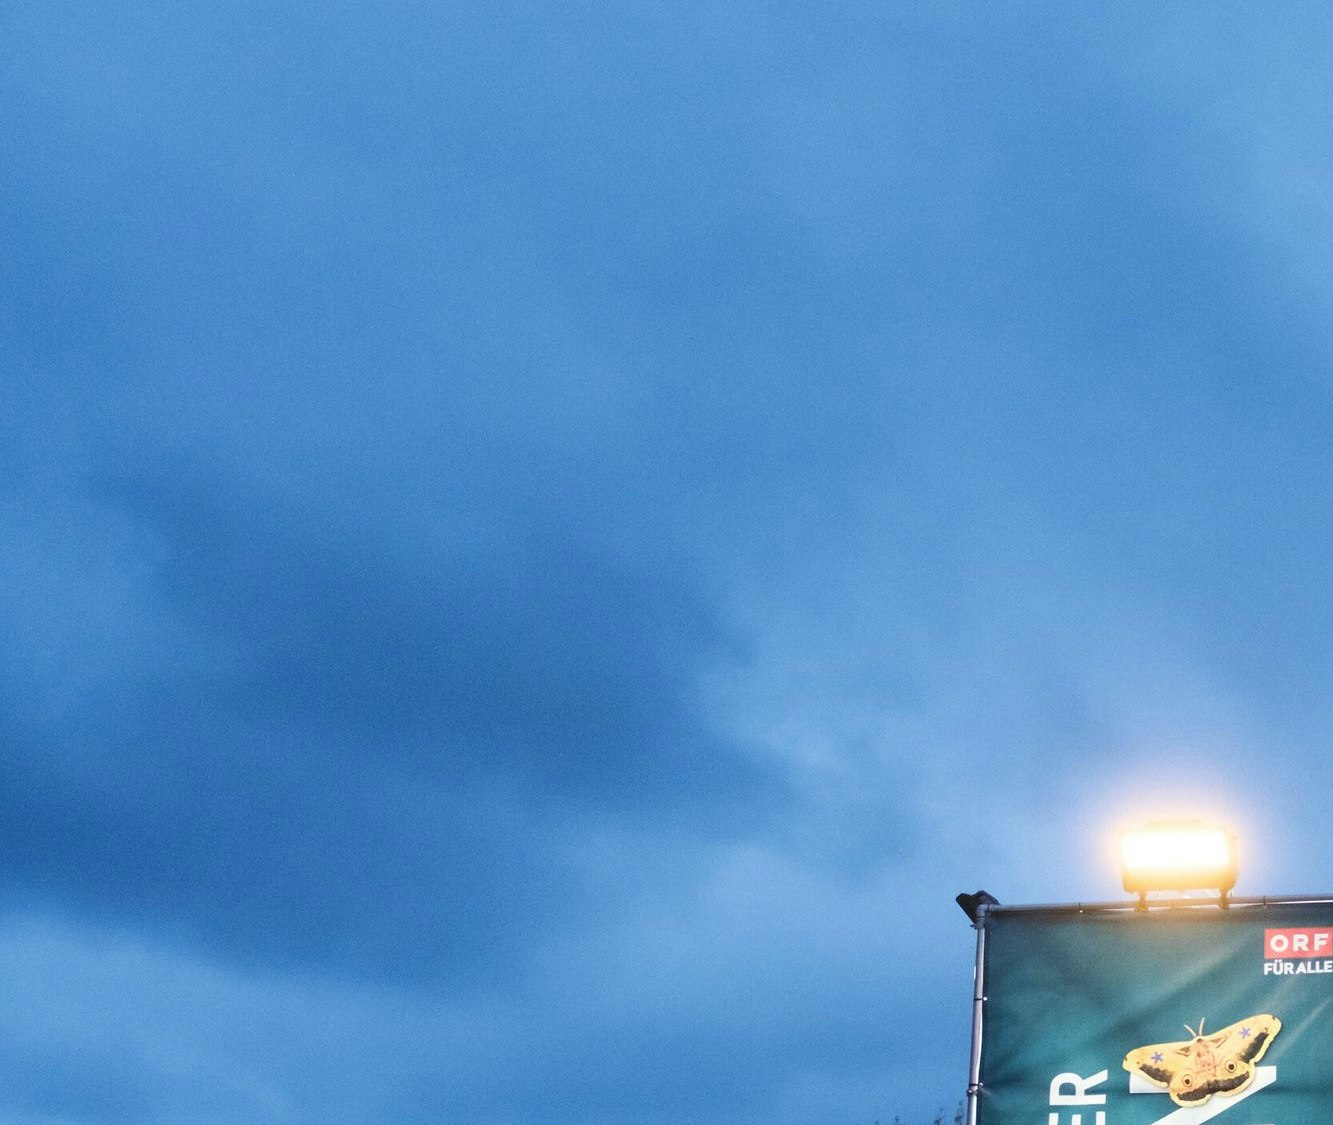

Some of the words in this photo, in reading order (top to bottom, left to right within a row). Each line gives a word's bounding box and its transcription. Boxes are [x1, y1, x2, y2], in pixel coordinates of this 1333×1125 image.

[1270, 933, 1329, 952] ORF
[1264, 959, 1295, 976] FÜR
[1295, 960, 1333, 975] ALLE
